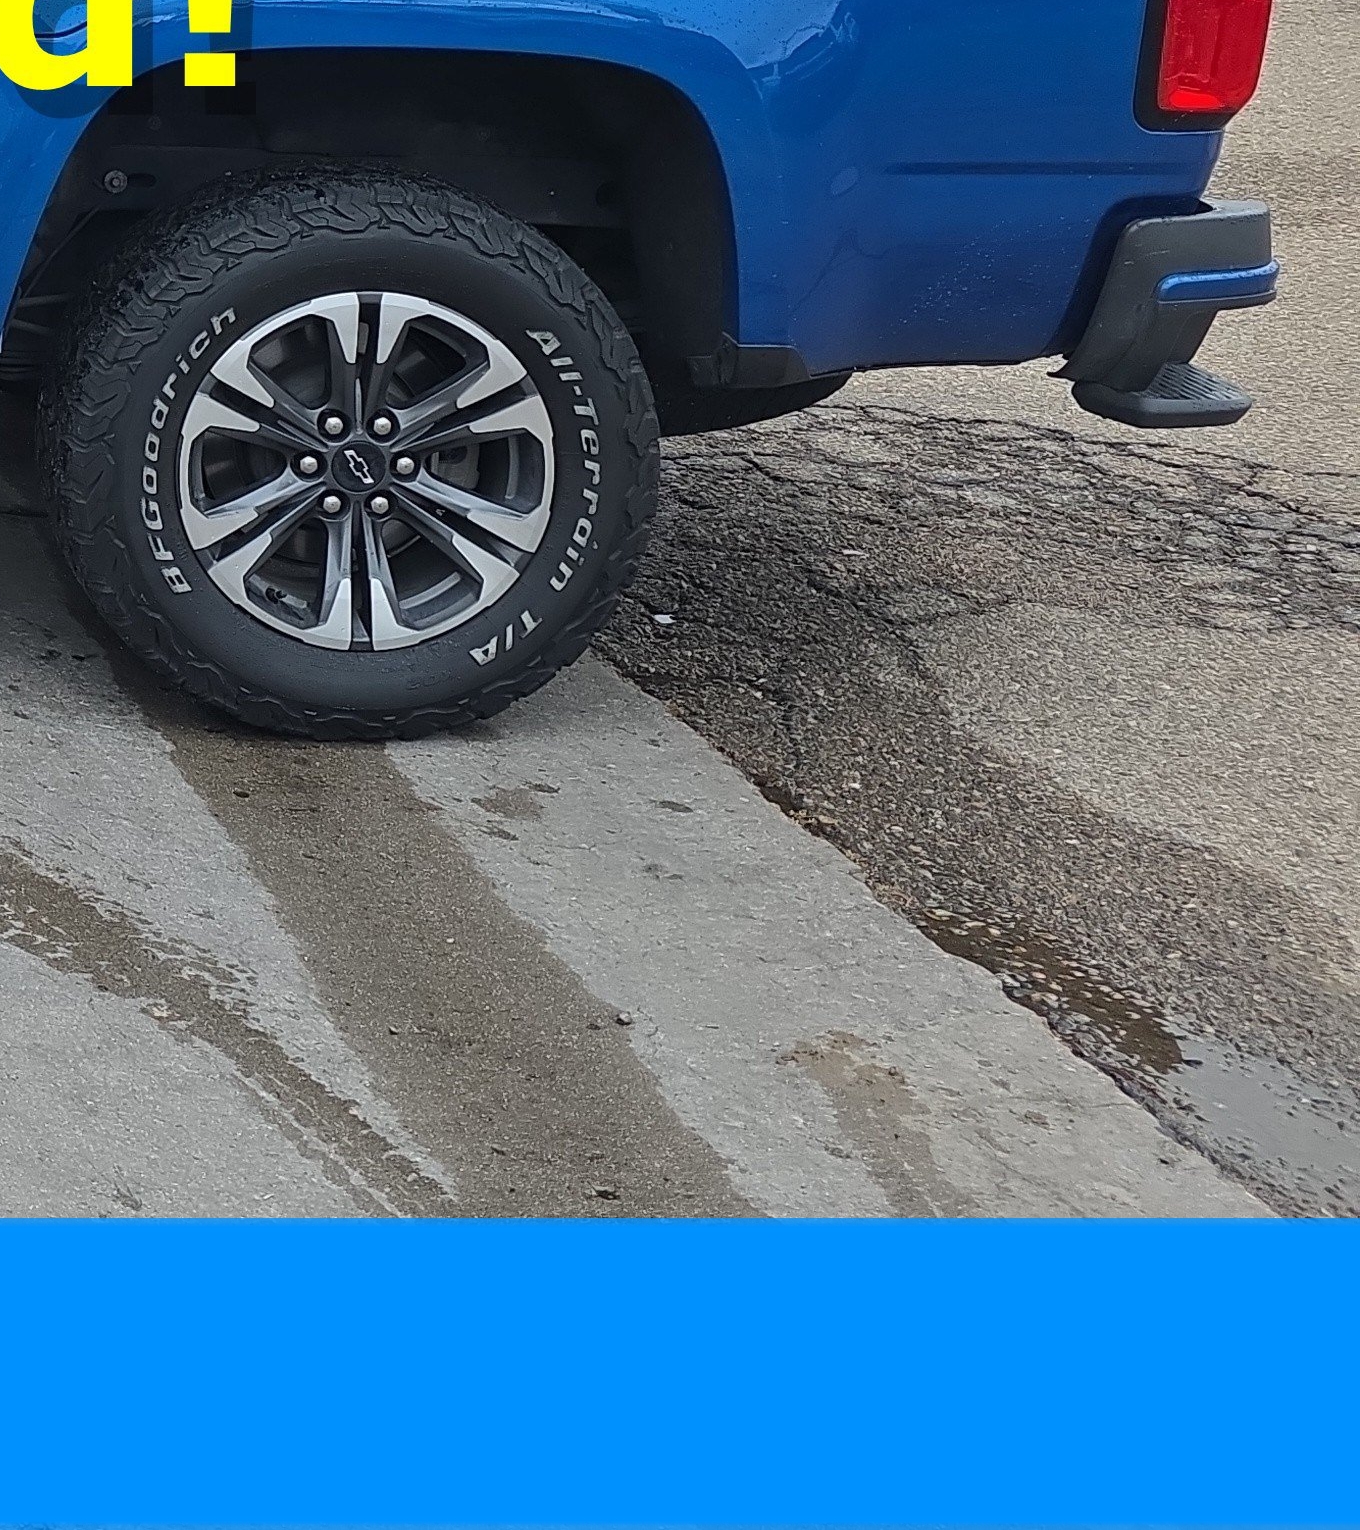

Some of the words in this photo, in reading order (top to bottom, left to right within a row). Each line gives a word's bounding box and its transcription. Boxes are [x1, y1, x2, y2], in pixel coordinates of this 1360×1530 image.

[138, 302, 239, 596] BFGoodrich
[526, 327, 603, 593] All-Terrain
[468, 606, 544, 667] T/A
